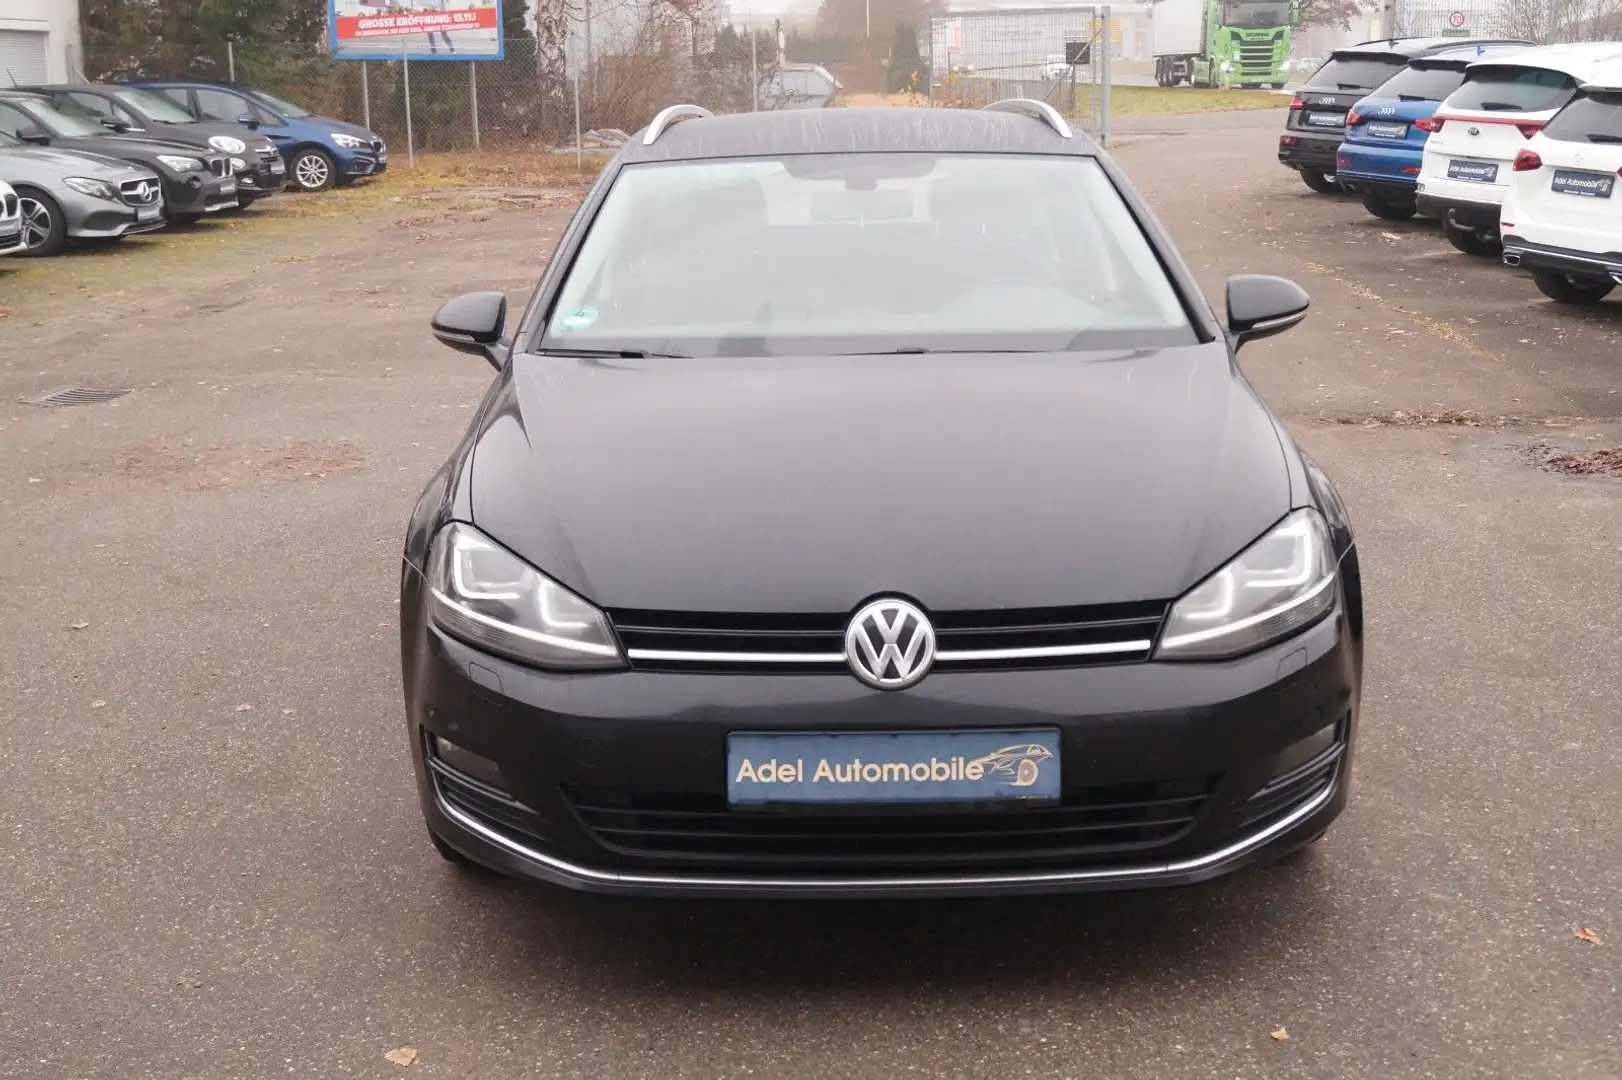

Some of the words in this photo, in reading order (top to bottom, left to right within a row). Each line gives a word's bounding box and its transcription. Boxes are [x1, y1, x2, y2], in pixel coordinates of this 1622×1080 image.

[358, 18, 395, 28] GROSSE
[396, 14, 452, 26] ERÖFFNUNG:
[1554, 176, 1567, 185] Adel
[735, 758, 803, 783] Adel
[812, 757, 985, 783] Automobile
